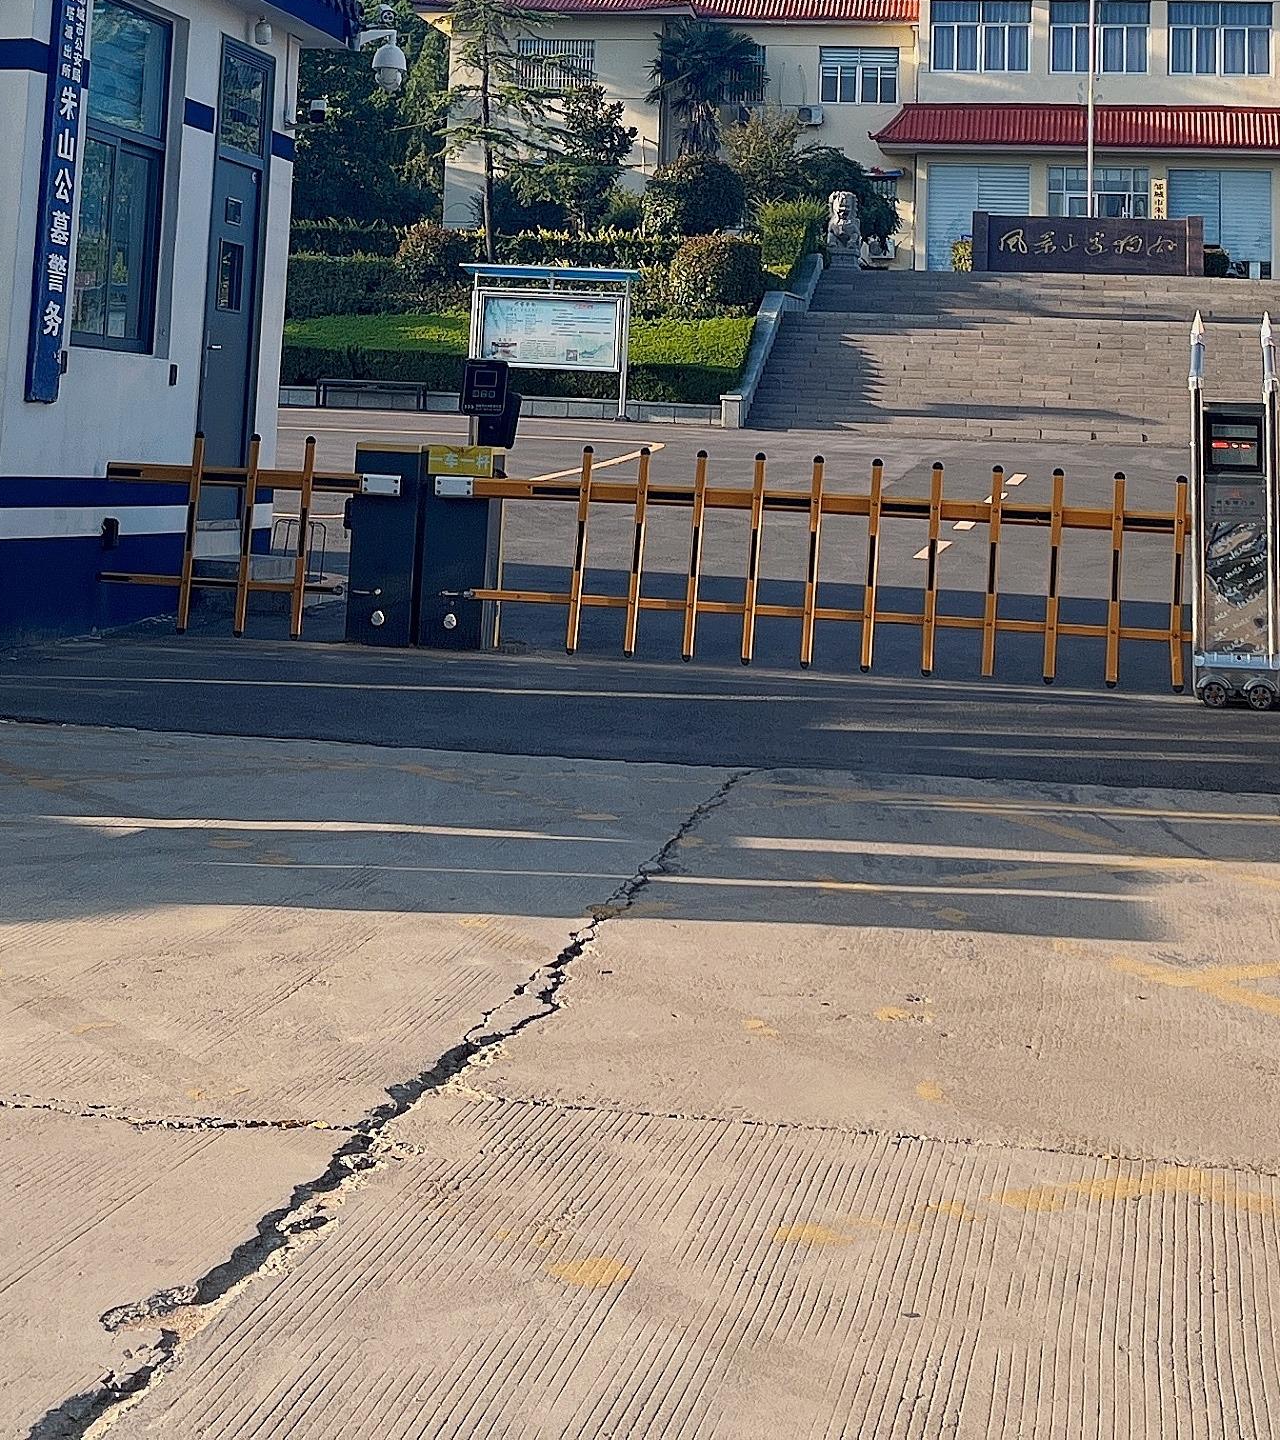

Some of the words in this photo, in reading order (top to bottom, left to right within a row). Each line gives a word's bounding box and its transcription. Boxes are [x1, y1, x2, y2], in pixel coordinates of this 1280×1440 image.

[43, 86, 79, 364] 朱山公墓警务
